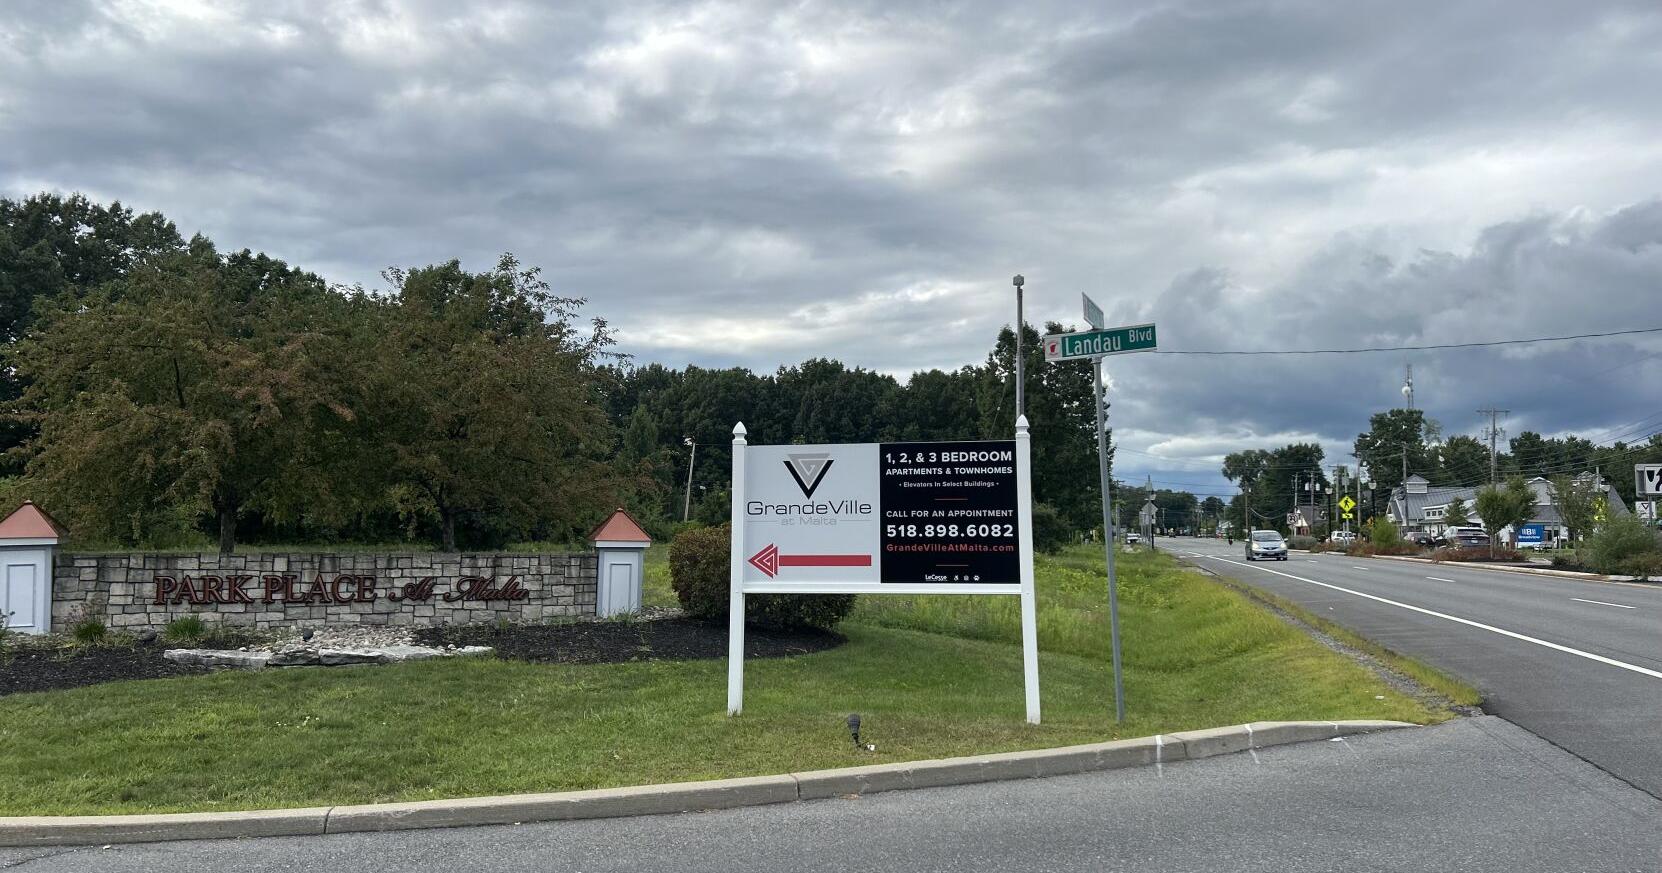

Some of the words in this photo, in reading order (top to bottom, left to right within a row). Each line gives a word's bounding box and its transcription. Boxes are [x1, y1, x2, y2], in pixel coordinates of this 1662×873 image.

[1065, 335, 1121, 356] Landau
[1128, 327, 1152, 343] Blvd
[885, 453, 896, 465] 1,
[899, 452, 912, 464] 2,
[915, 452, 925, 463] &
[928, 452, 937, 463] 3
[941, 451, 1012, 463] BEDROOM
[885, 467, 943, 476] APARTMENTS
[945, 467, 952, 475] &
[954, 466, 1013, 475] TOWNHOMES
[964, 480, 995, 488] Buildings
[747, 500, 872, 516] GrandeVille
[886, 510, 908, 518] CALL
[947, 509, 1014, 518] APPOINTMENT
[781, 517, 795, 526] at
[799, 516, 837, 526] Malta
[886, 524, 1014, 538] 518.898.6082
[886, 543, 1014, 552] GrandeVilleAtMalta.com
[153, 574, 255, 605] PARK
[262, 573, 378, 605] PLACE
